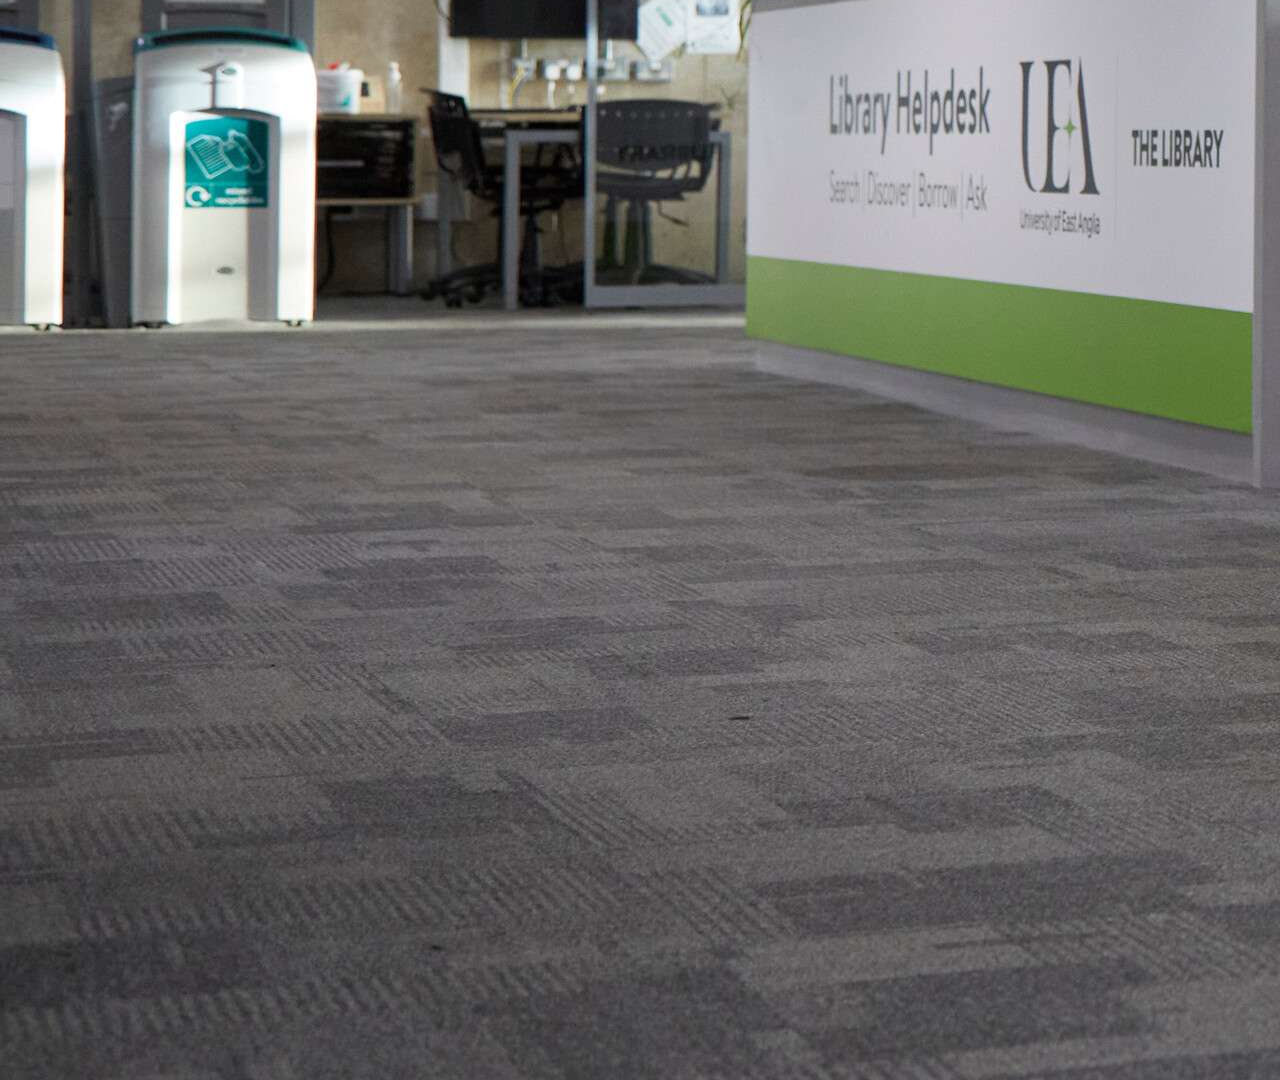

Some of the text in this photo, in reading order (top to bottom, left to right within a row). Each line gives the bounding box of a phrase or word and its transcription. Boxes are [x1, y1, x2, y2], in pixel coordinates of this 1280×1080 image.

[829, 65, 990, 156] Library Helpdesk
[1019, 56, 1101, 195] UEA
[1131, 129, 1224, 168] THE LIBRARY
[829, 170, 988, 211] Search Discover Borrow Ask
[1054, 210, 1061, 231] of
[1062, 210, 1077, 233] East
[1078, 211, 1101, 238] Anglia
